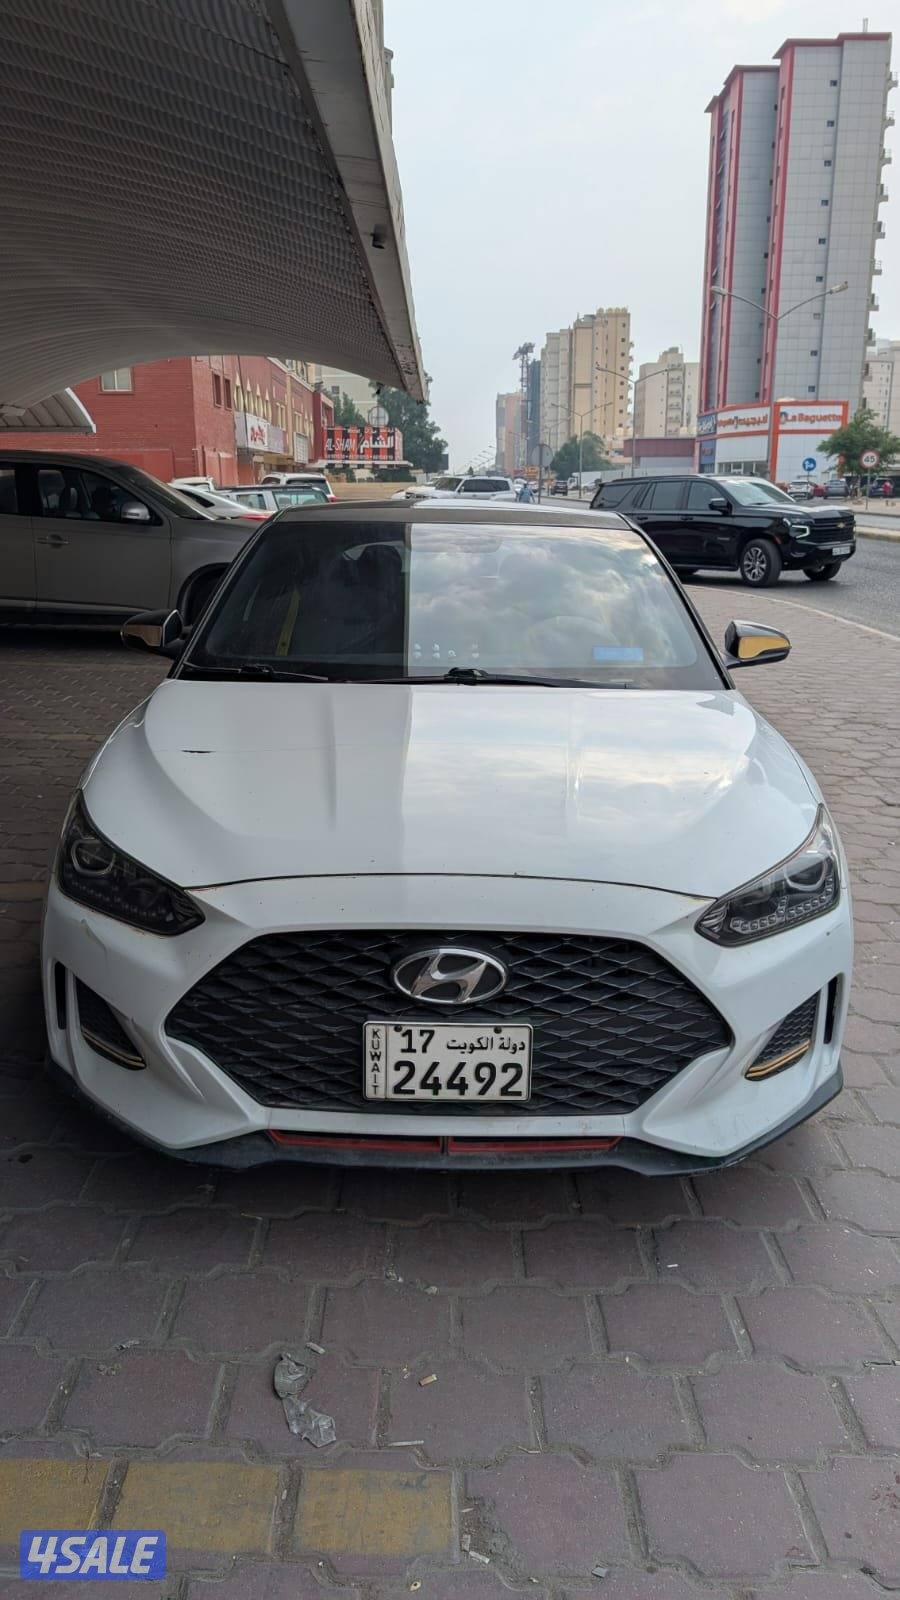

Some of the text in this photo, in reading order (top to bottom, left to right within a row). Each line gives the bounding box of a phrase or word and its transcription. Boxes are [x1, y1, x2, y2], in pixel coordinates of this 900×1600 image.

[786, 412, 841, 425] La Baguette
[360, 434, 395, 454] الشام
[864, 455, 876, 463] 45
[400, 1028, 436, 1054] 17
[446, 1035, 526, 1055] دولة الكويت
[369, 1028, 382, 1095] KUWAIT
[392, 1060, 524, 1097] 24492
